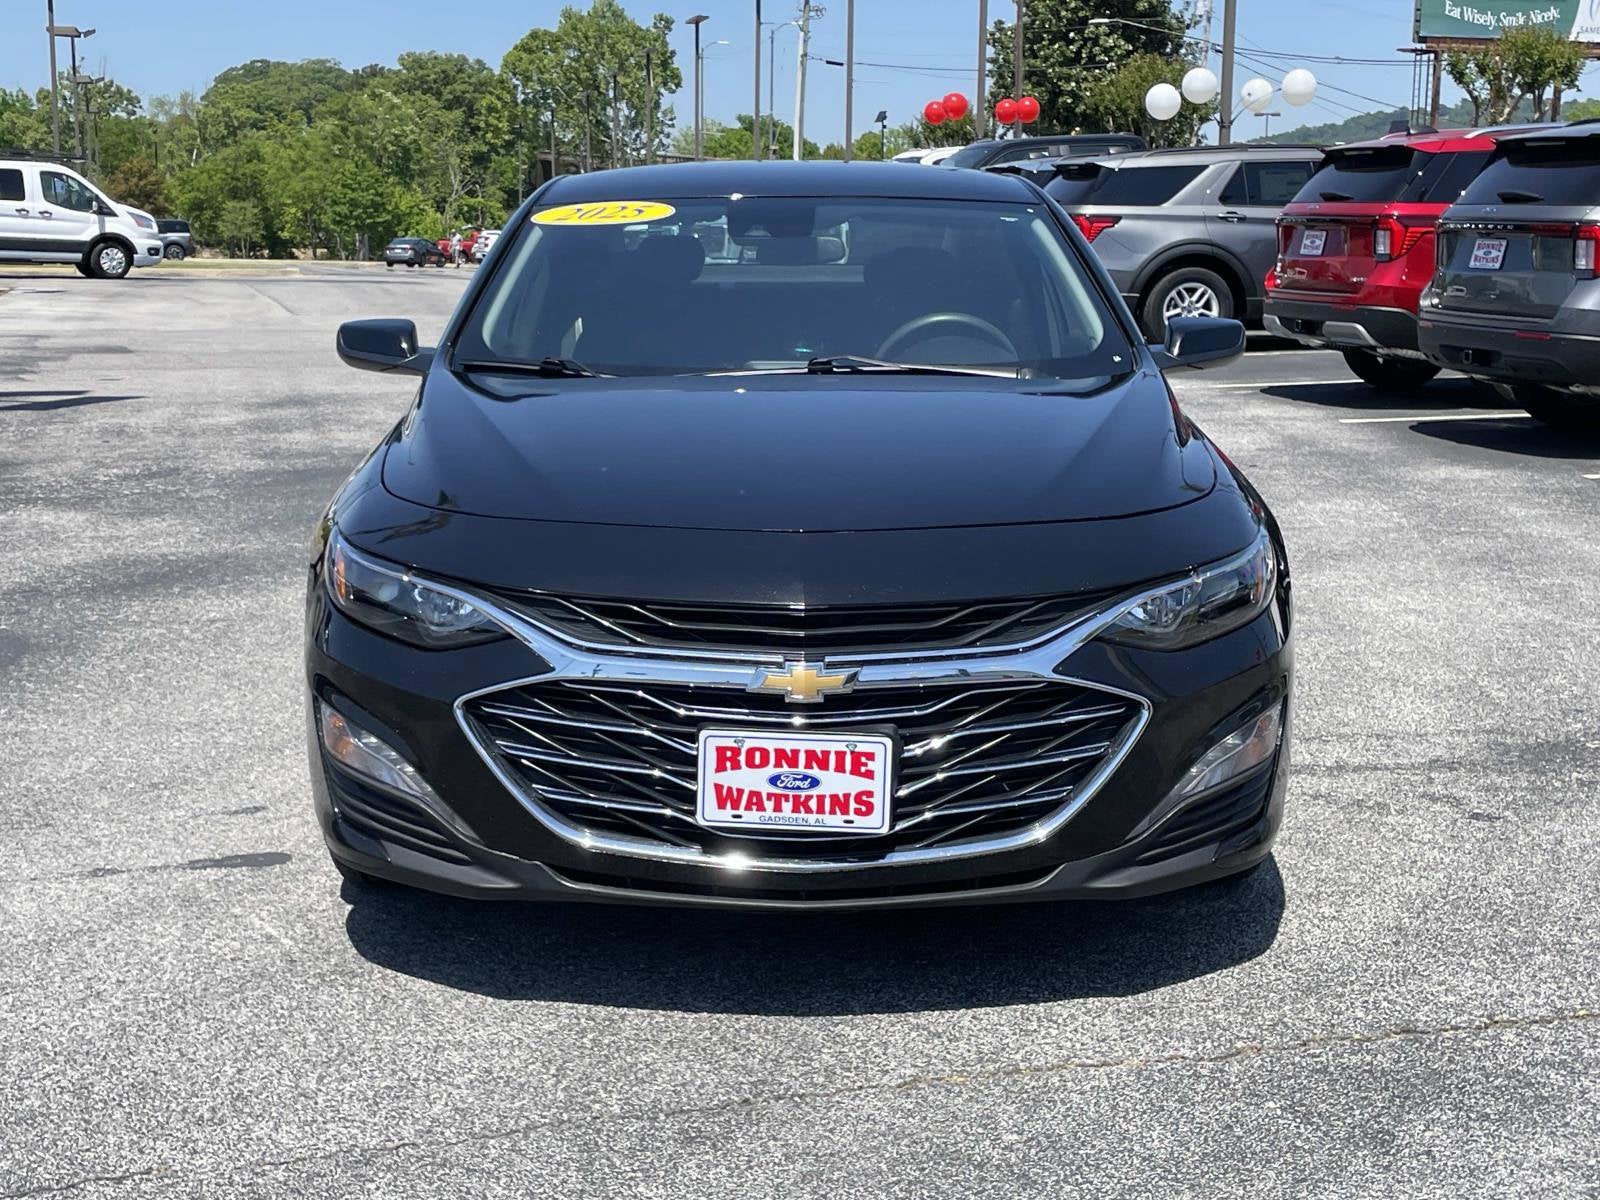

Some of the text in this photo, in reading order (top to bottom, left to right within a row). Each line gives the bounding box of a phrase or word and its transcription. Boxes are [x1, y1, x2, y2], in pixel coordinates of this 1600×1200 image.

[1445, 0, 1461, 19] Eat
[1463, 6, 1497, 30] Wisely.
[1499, 11, 1527, 27] Smile
[553, 205, 654, 221] 2025
[715, 745, 875, 780] RONNIE
[777, 773, 811, 789] Ford
[713, 783, 875, 817] WATKINS
[758, 815, 812, 826] GADSDEN,
